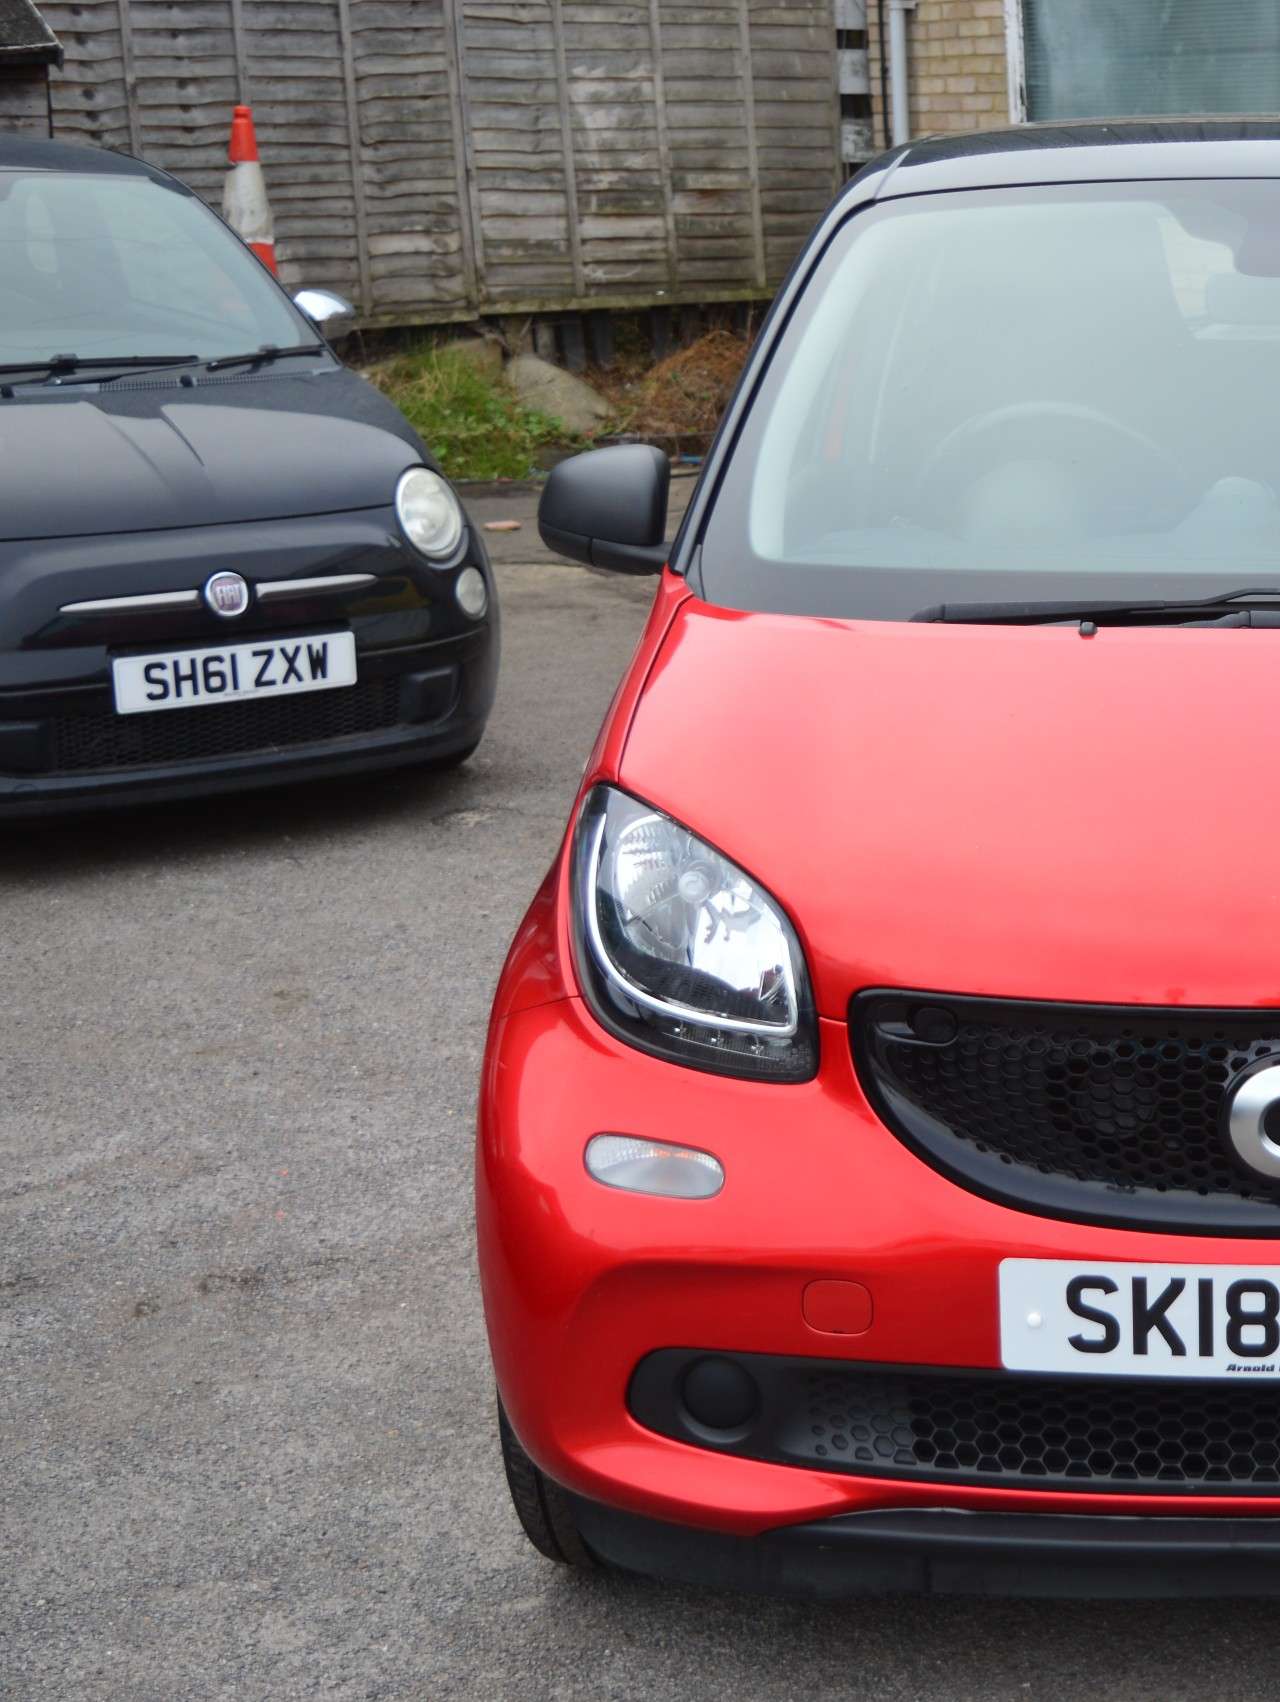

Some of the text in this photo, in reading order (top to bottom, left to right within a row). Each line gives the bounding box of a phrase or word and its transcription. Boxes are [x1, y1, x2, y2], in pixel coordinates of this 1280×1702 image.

[144, 641, 328, 701] SH61 ZXW
[1065, 1274, 1280, 1358] SK18
[1226, 1363, 1275, 1373] Arnold
